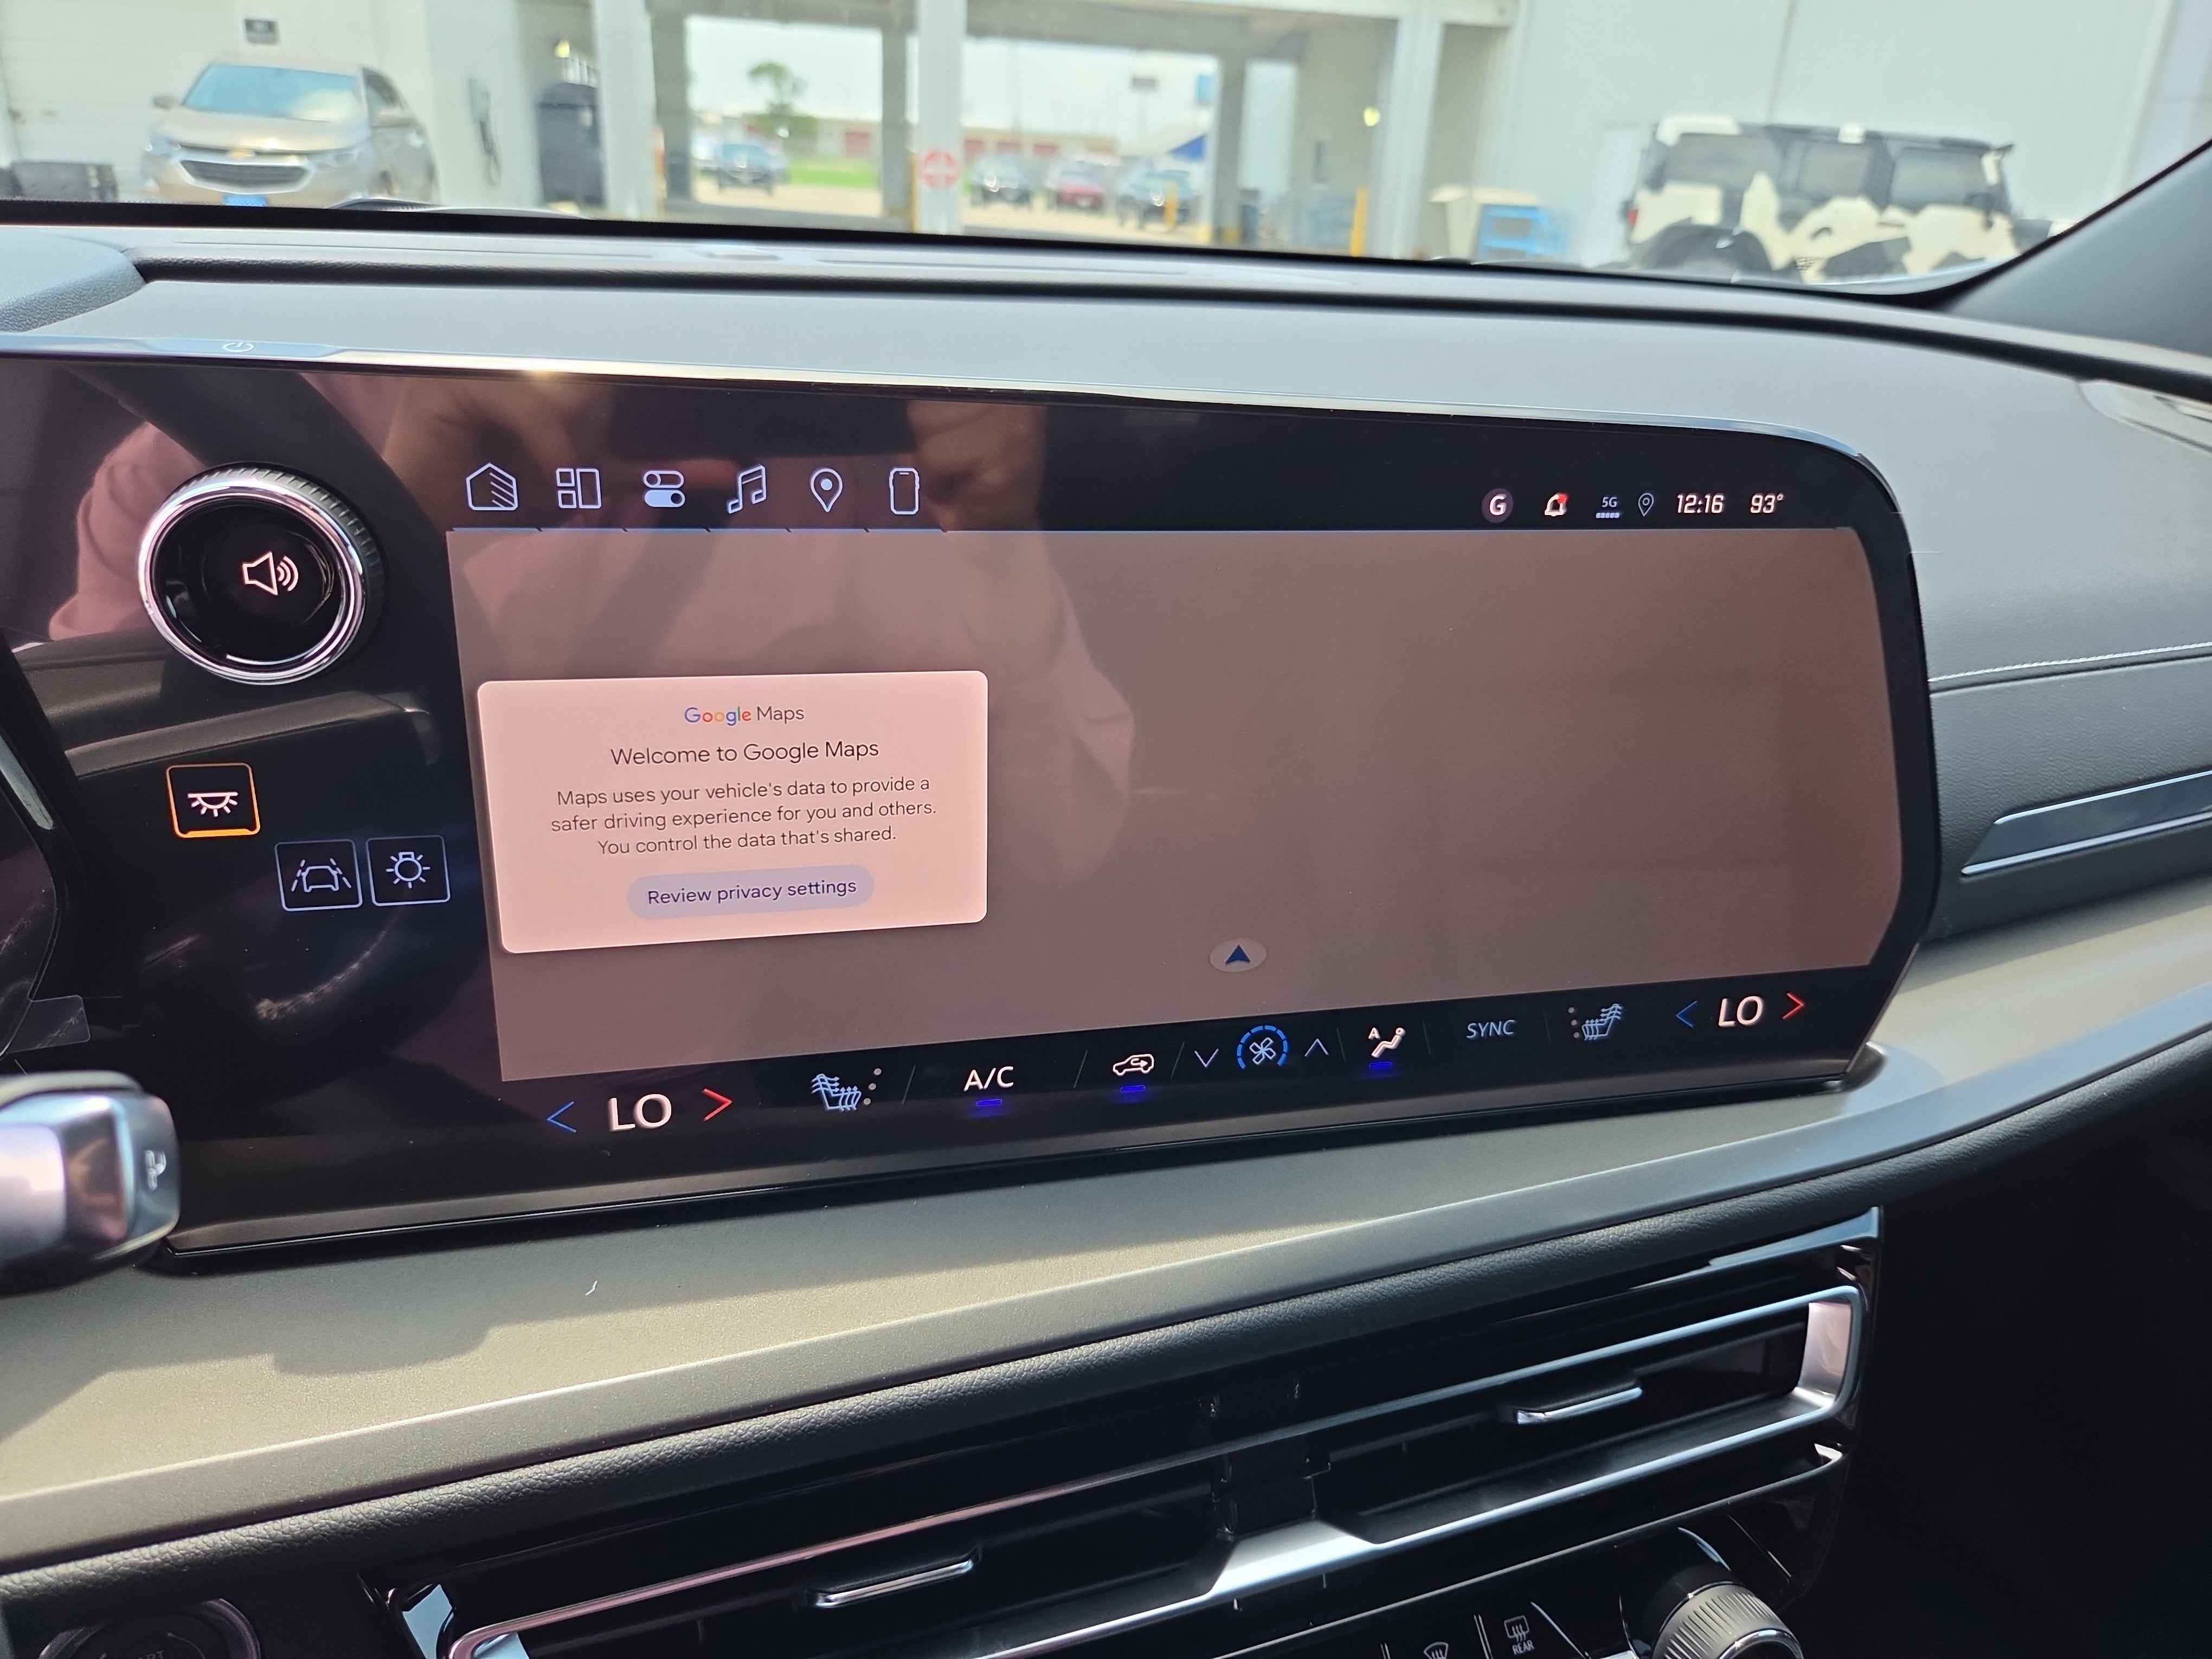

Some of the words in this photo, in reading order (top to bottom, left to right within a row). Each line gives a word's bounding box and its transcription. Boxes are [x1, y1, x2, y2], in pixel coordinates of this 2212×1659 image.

[1489, 494, 1507, 516] G
[1602, 497, 1617, 508] 5G
[1677, 493, 1725, 513] 12:16
[684, 706, 752, 726] Google
[757, 706, 805, 723] Maps
[610, 747, 710, 765] Welcome
[716, 746, 737, 762] to
[743, 742, 819, 764] Google
[826, 741, 879, 761] Maps
[557, 790, 607, 808] Maps
[613, 790, 656, 803] uses
[660, 788, 700, 805] your
[705, 782, 782, 799] vehicle's
[787, 780, 825, 796] data
[830, 781, 847, 794] to
[852, 776, 915, 797] provide
[920, 779, 929, 790] a
[551, 814, 598, 832] safer
[604, 812, 666, 831] driving
[672, 808, 772, 829] experience
[776, 805, 801, 821] for
[806, 808, 837, 824] you
[842, 801, 873, 818] and
[878, 800, 936, 816] others.
[597, 840, 630, 854] You
[635, 834, 697, 853] control
[703, 834, 732, 850] the
[737, 832, 776, 848] data
[780, 829, 829, 845] that's
[834, 825, 896, 843] shared.
[648, 888, 712, 904] Review
[717, 884, 783, 904] privacy
[788, 879, 857, 897] settings
[1718, 995, 1764, 1027] LO
[1368, 1027, 1381, 1040] A
[1466, 1019, 1516, 1039] SYNC
[963, 1066, 1014, 1091] A/C
[609, 1094, 672, 1131] LO
[1512, 1639, 1535, 1655] REAR
